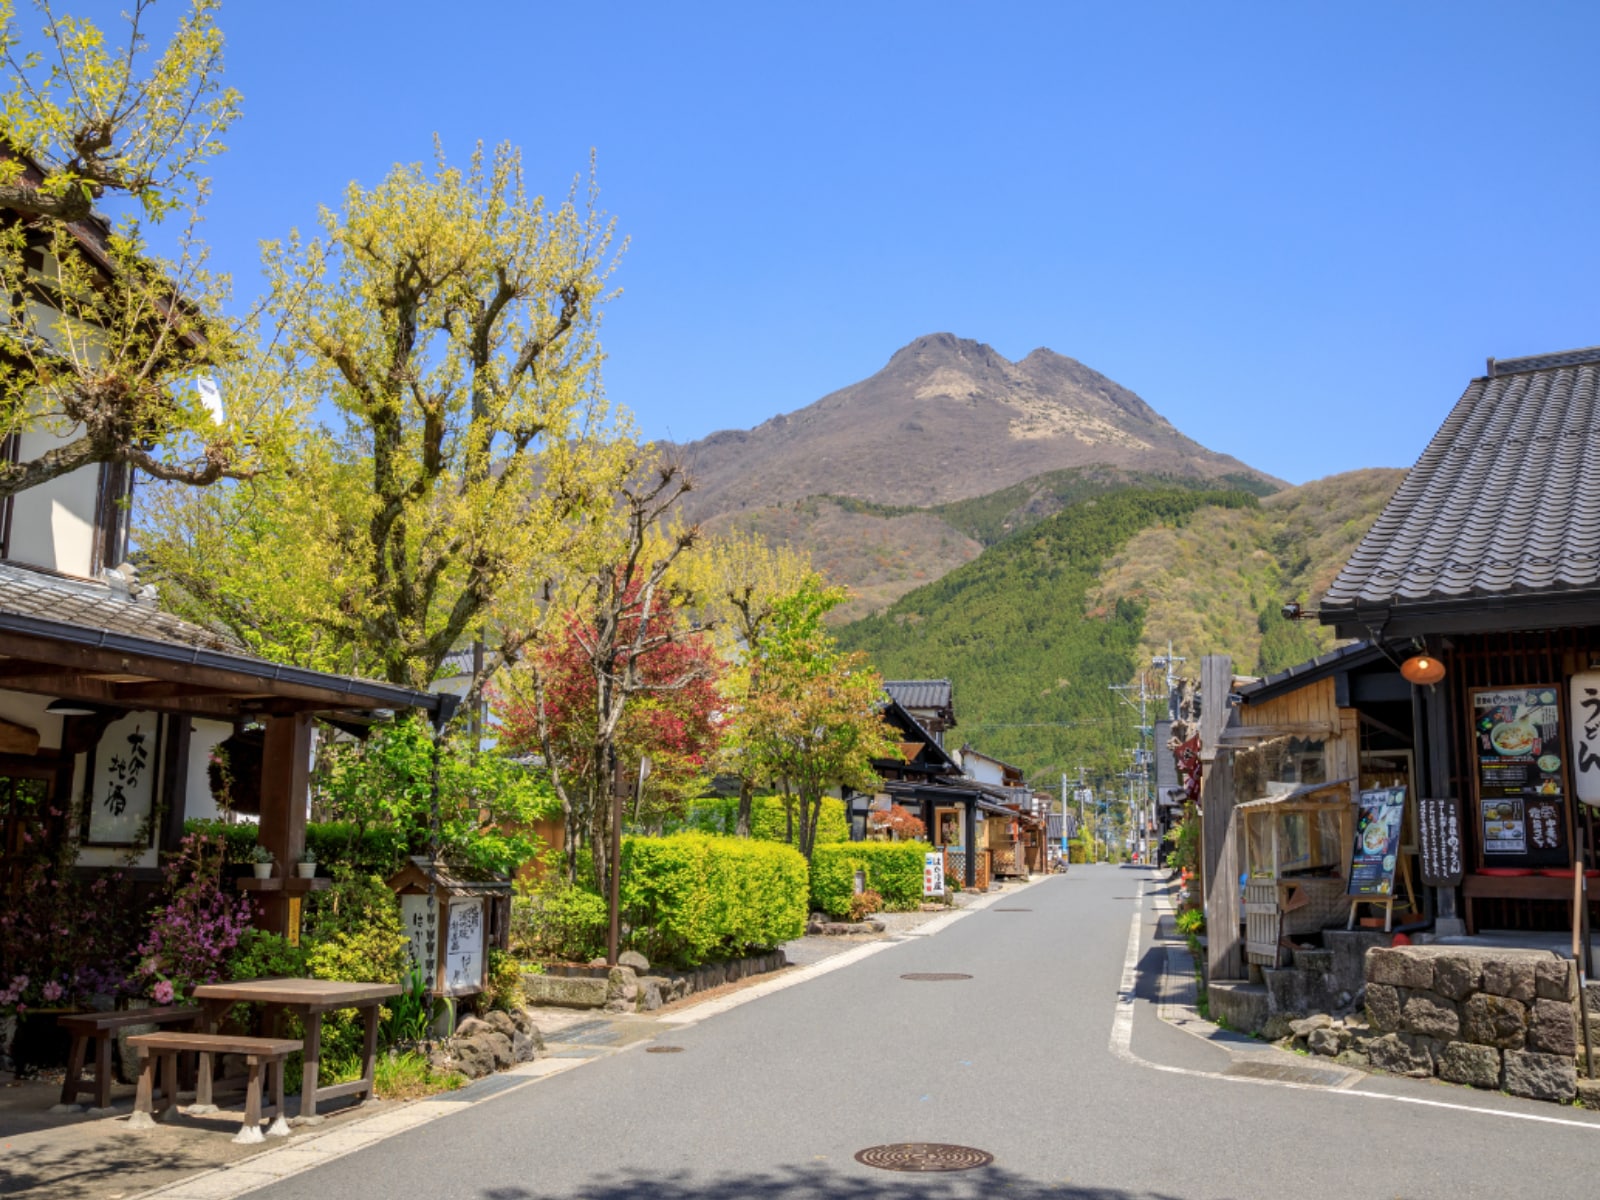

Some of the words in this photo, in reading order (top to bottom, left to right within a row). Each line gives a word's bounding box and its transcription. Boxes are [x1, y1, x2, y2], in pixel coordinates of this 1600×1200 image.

[1578, 688, 1600, 773] うどん
[104, 754, 126, 817] 地酒
